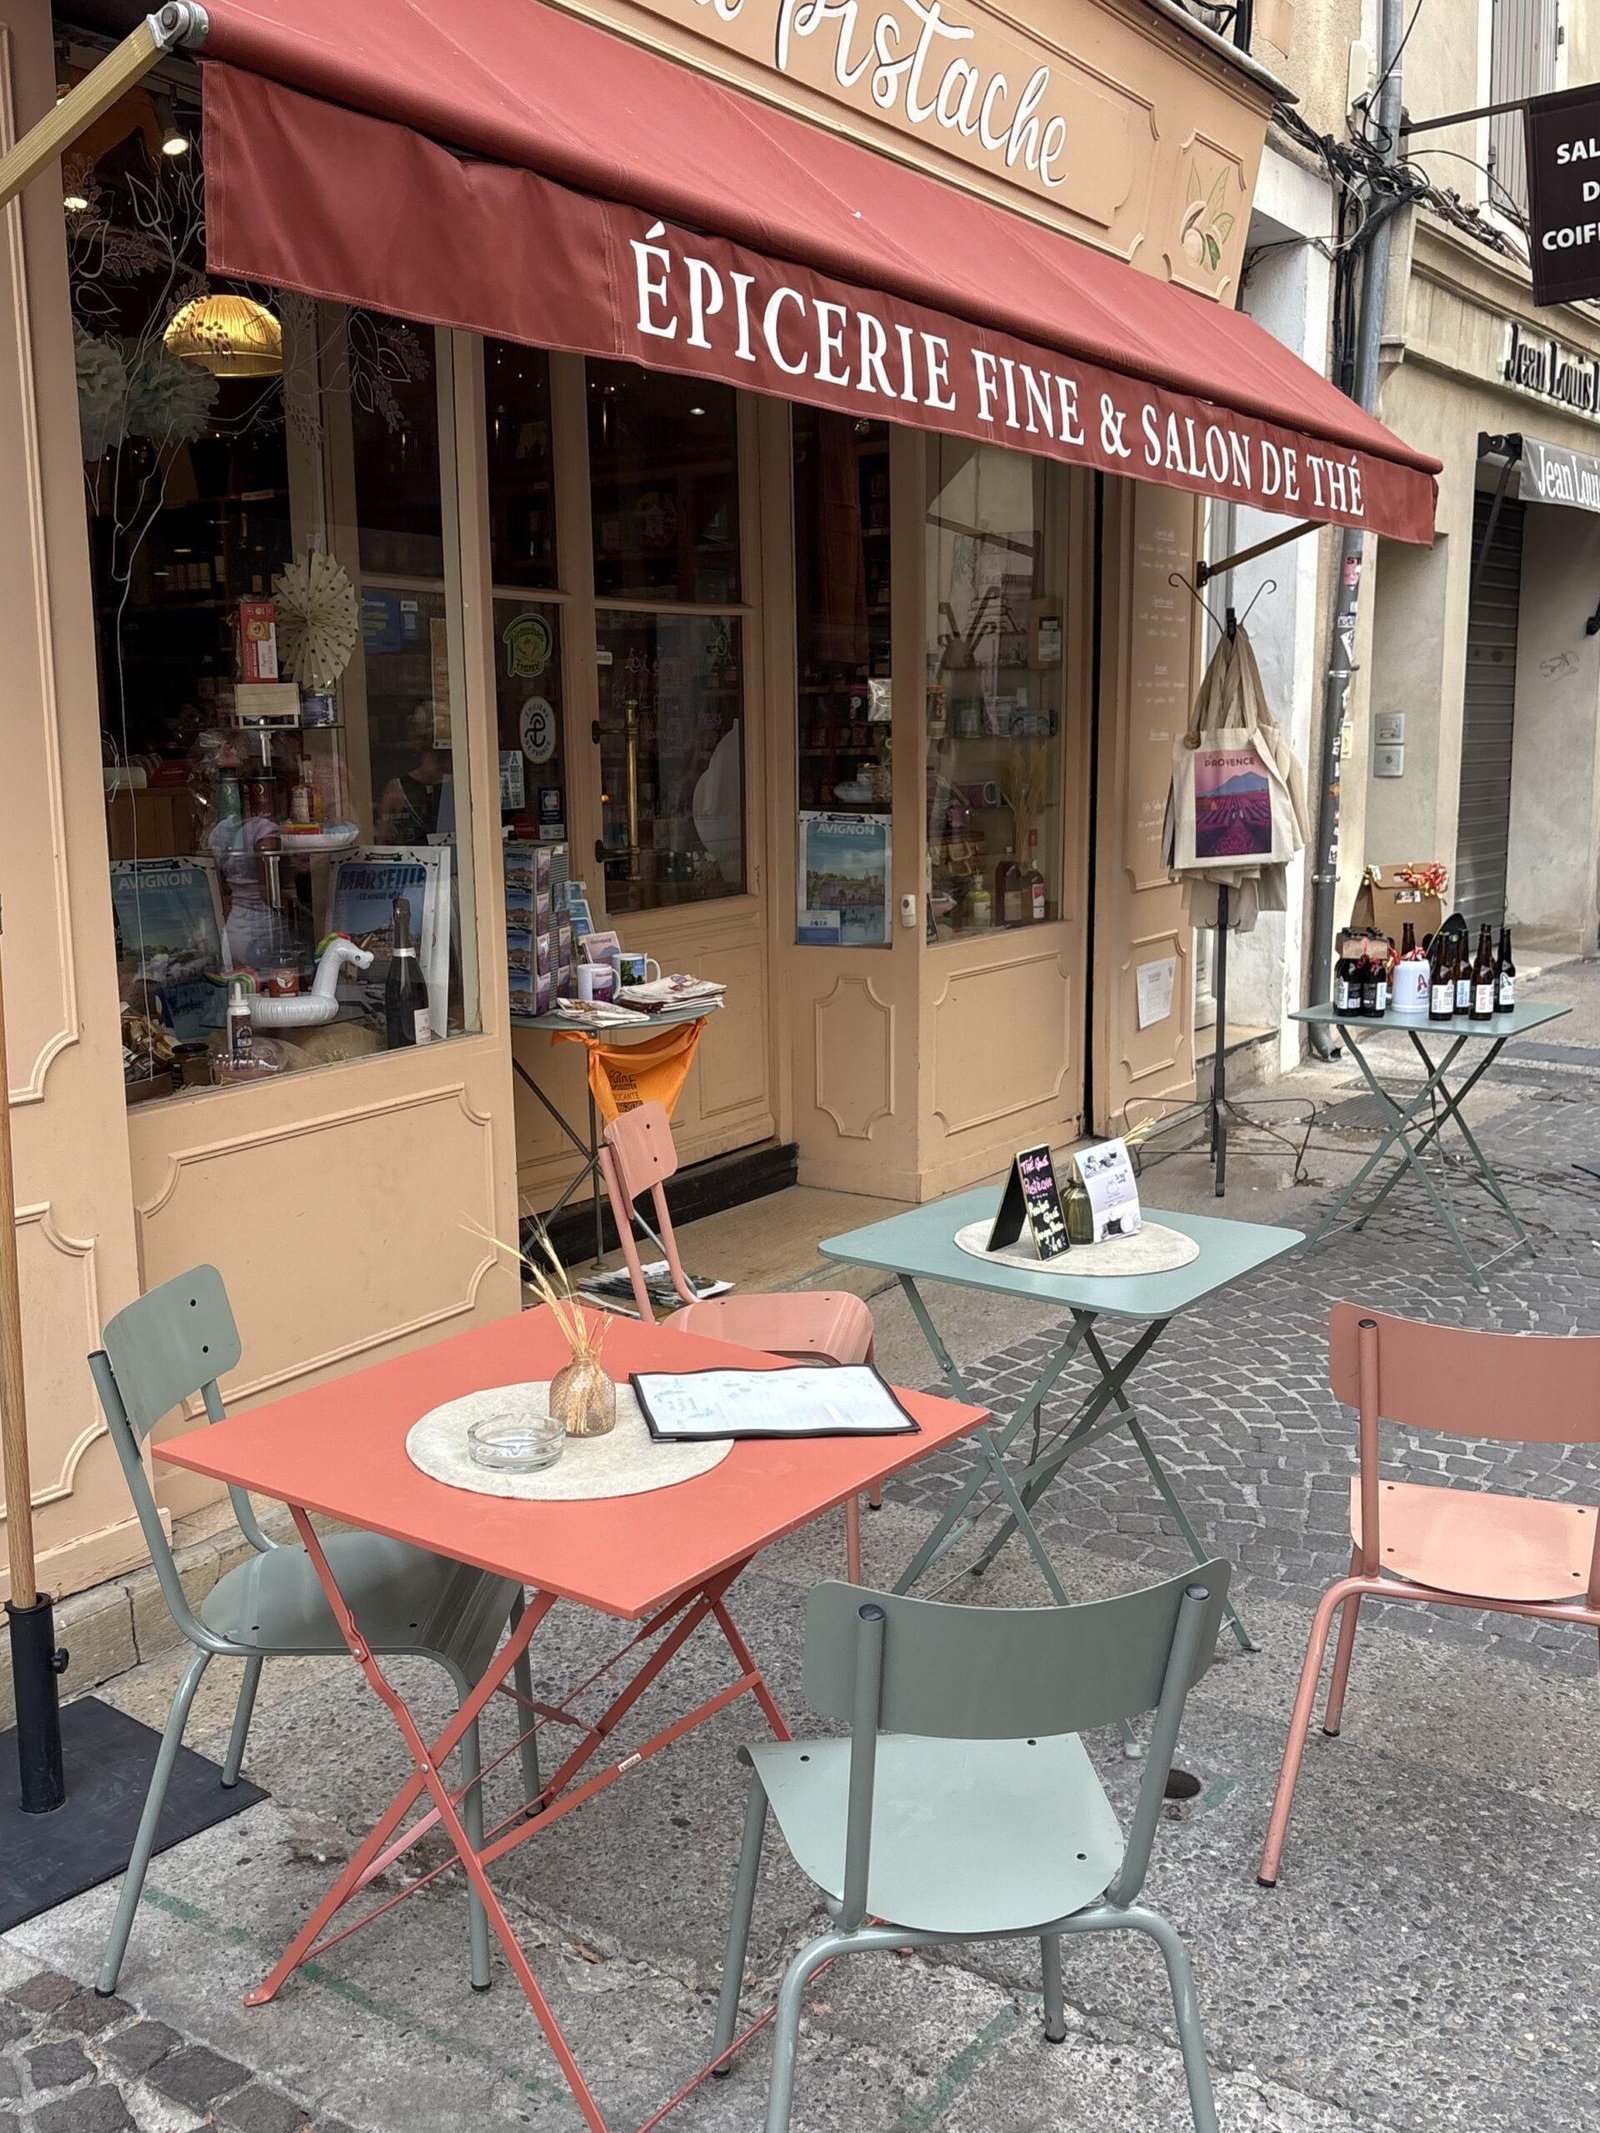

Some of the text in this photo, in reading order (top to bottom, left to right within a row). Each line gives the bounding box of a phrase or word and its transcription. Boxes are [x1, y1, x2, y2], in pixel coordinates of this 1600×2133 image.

[1556, 138, 1600, 165] SAL
[1582, 181, 1600, 202] D
[1542, 222, 1600, 251] COIF
[629, 220, 1365, 517] ÉPICERIE FINE & SALON DE THÉ
[1503, 323, 1546, 394] Jean
[1548, 341, 1592, 411] Louis
[1538, 445, 1575, 502] Jean
[1204, 757, 1255, 768] PROVENCE
[817, 824, 875, 836] AVIGNON
[119, 872, 194, 890] AVIGNON
